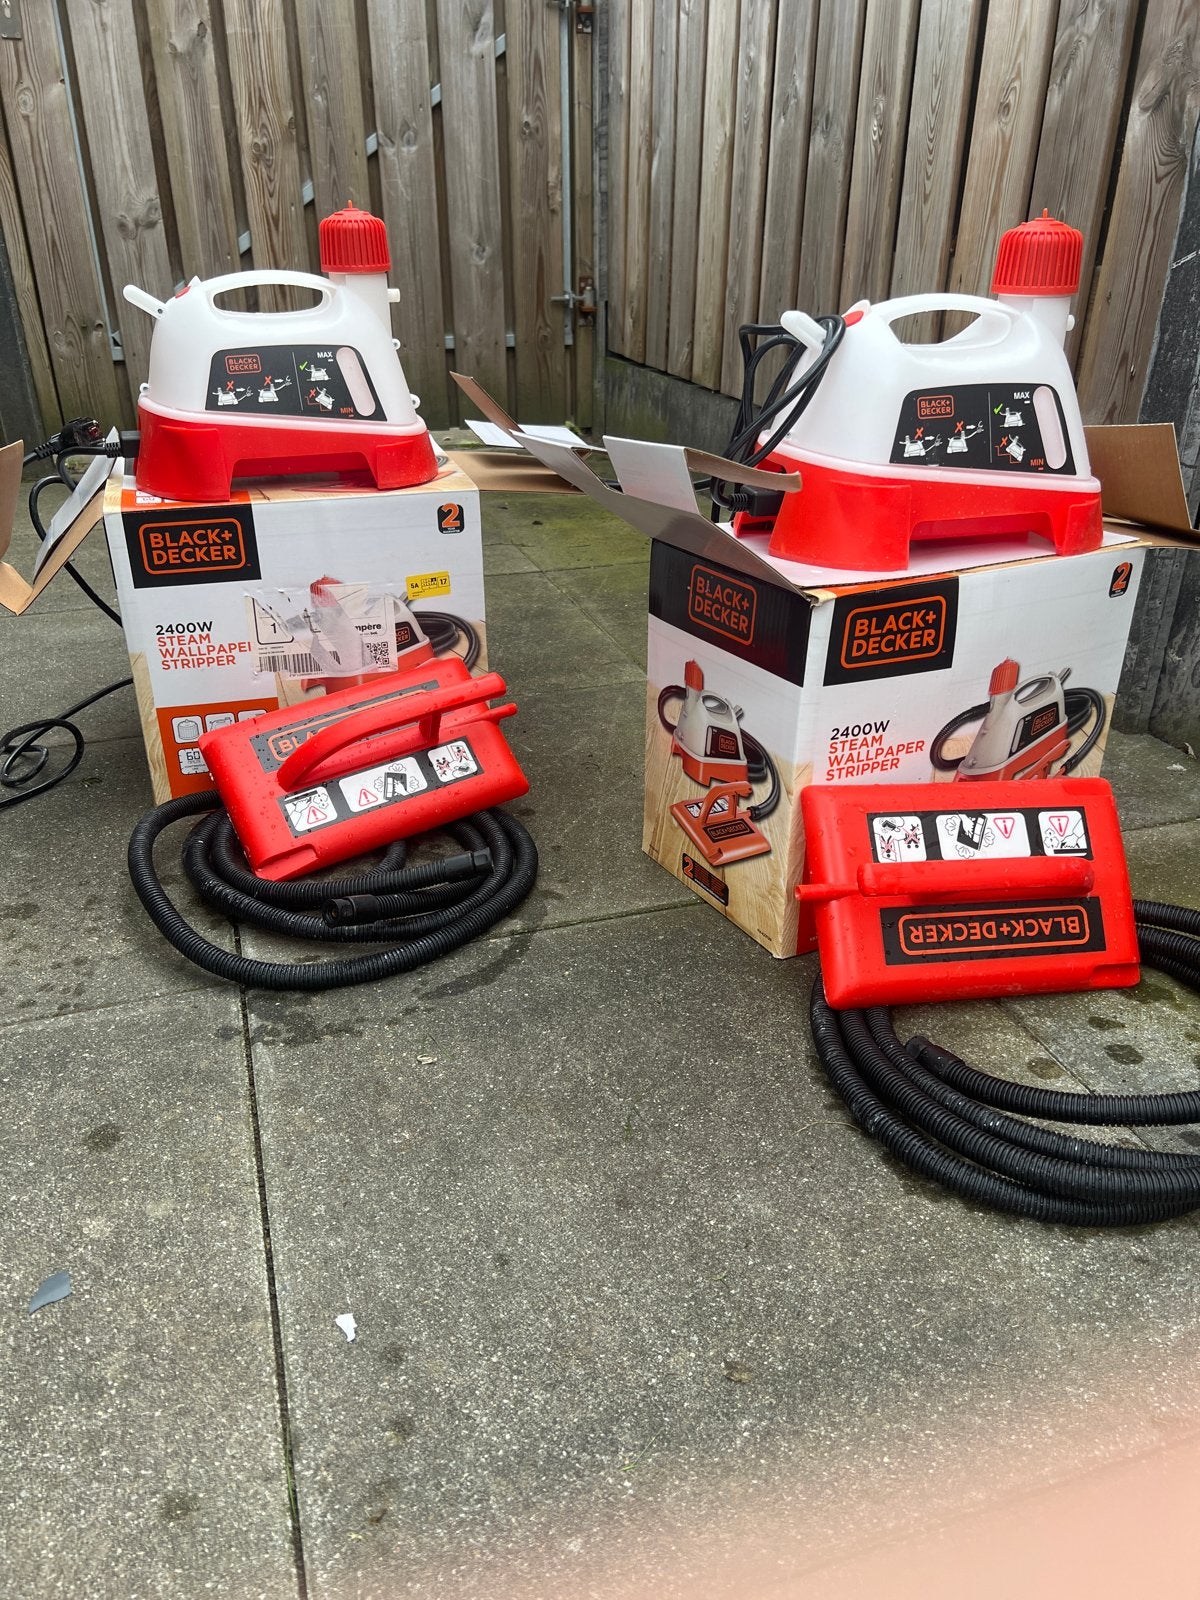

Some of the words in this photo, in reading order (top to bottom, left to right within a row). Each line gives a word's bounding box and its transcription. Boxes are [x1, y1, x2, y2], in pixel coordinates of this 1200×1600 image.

[229, 357, 258, 366] BLACK+
[230, 363, 258, 371] DECKER
[920, 400, 951, 409] BLACK+
[1014, 391, 1030, 399] MAX
[921, 406, 952, 416] DECKER
[1030, 458, 1044, 467] MIN
[441, 503, 460, 528] 2
[149, 528, 233, 549] BLACK+
[152, 545, 237, 566] DECKER
[1112, 561, 1131, 591] 2
[696, 576, 750, 611] BLACK+
[694, 595, 749, 634] DECKER
[854, 609, 937, 637] BLACK+
[155, 620, 213, 635] 2400W
[270, 622, 277, 634] 1
[157, 633, 211, 647] STEAM
[851, 628, 937, 657] DECKER
[161, 655, 237, 671] STRIPPER
[830, 719, 891, 741] 2400W
[828, 740, 925, 768] WALLPAPER
[829, 734, 884, 754] STEAM
[186, 750, 200, 761] 60
[826, 758, 900, 781] STRIPPER
[684, 855, 694, 879] 2
[909, 916, 1080, 944] BLACK+DECKER
